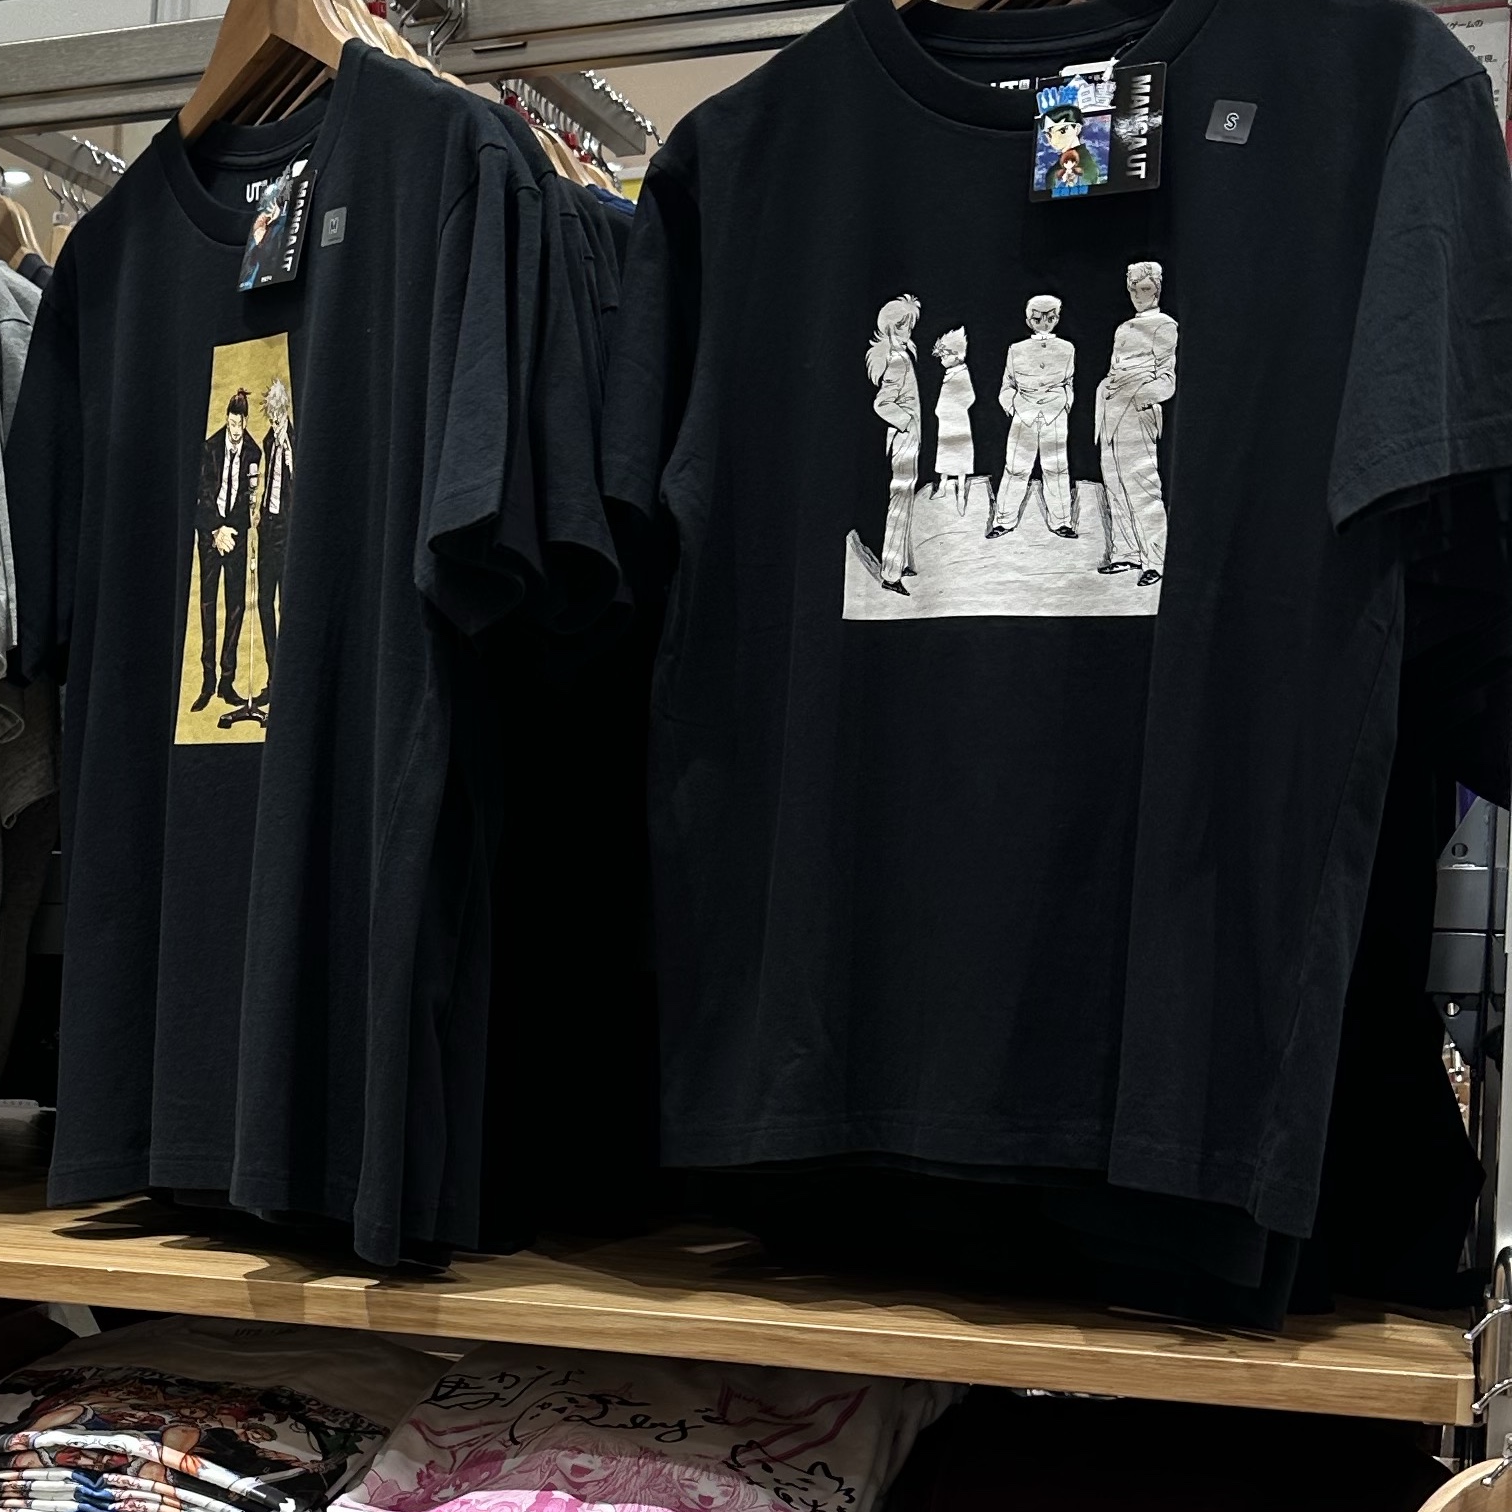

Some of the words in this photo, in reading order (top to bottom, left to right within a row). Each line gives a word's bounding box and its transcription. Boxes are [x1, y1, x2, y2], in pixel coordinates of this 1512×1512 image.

[1129, 74, 1152, 151] MANGA
[1224, 112, 1240, 132] S
[1126, 153, 1148, 179] UT
